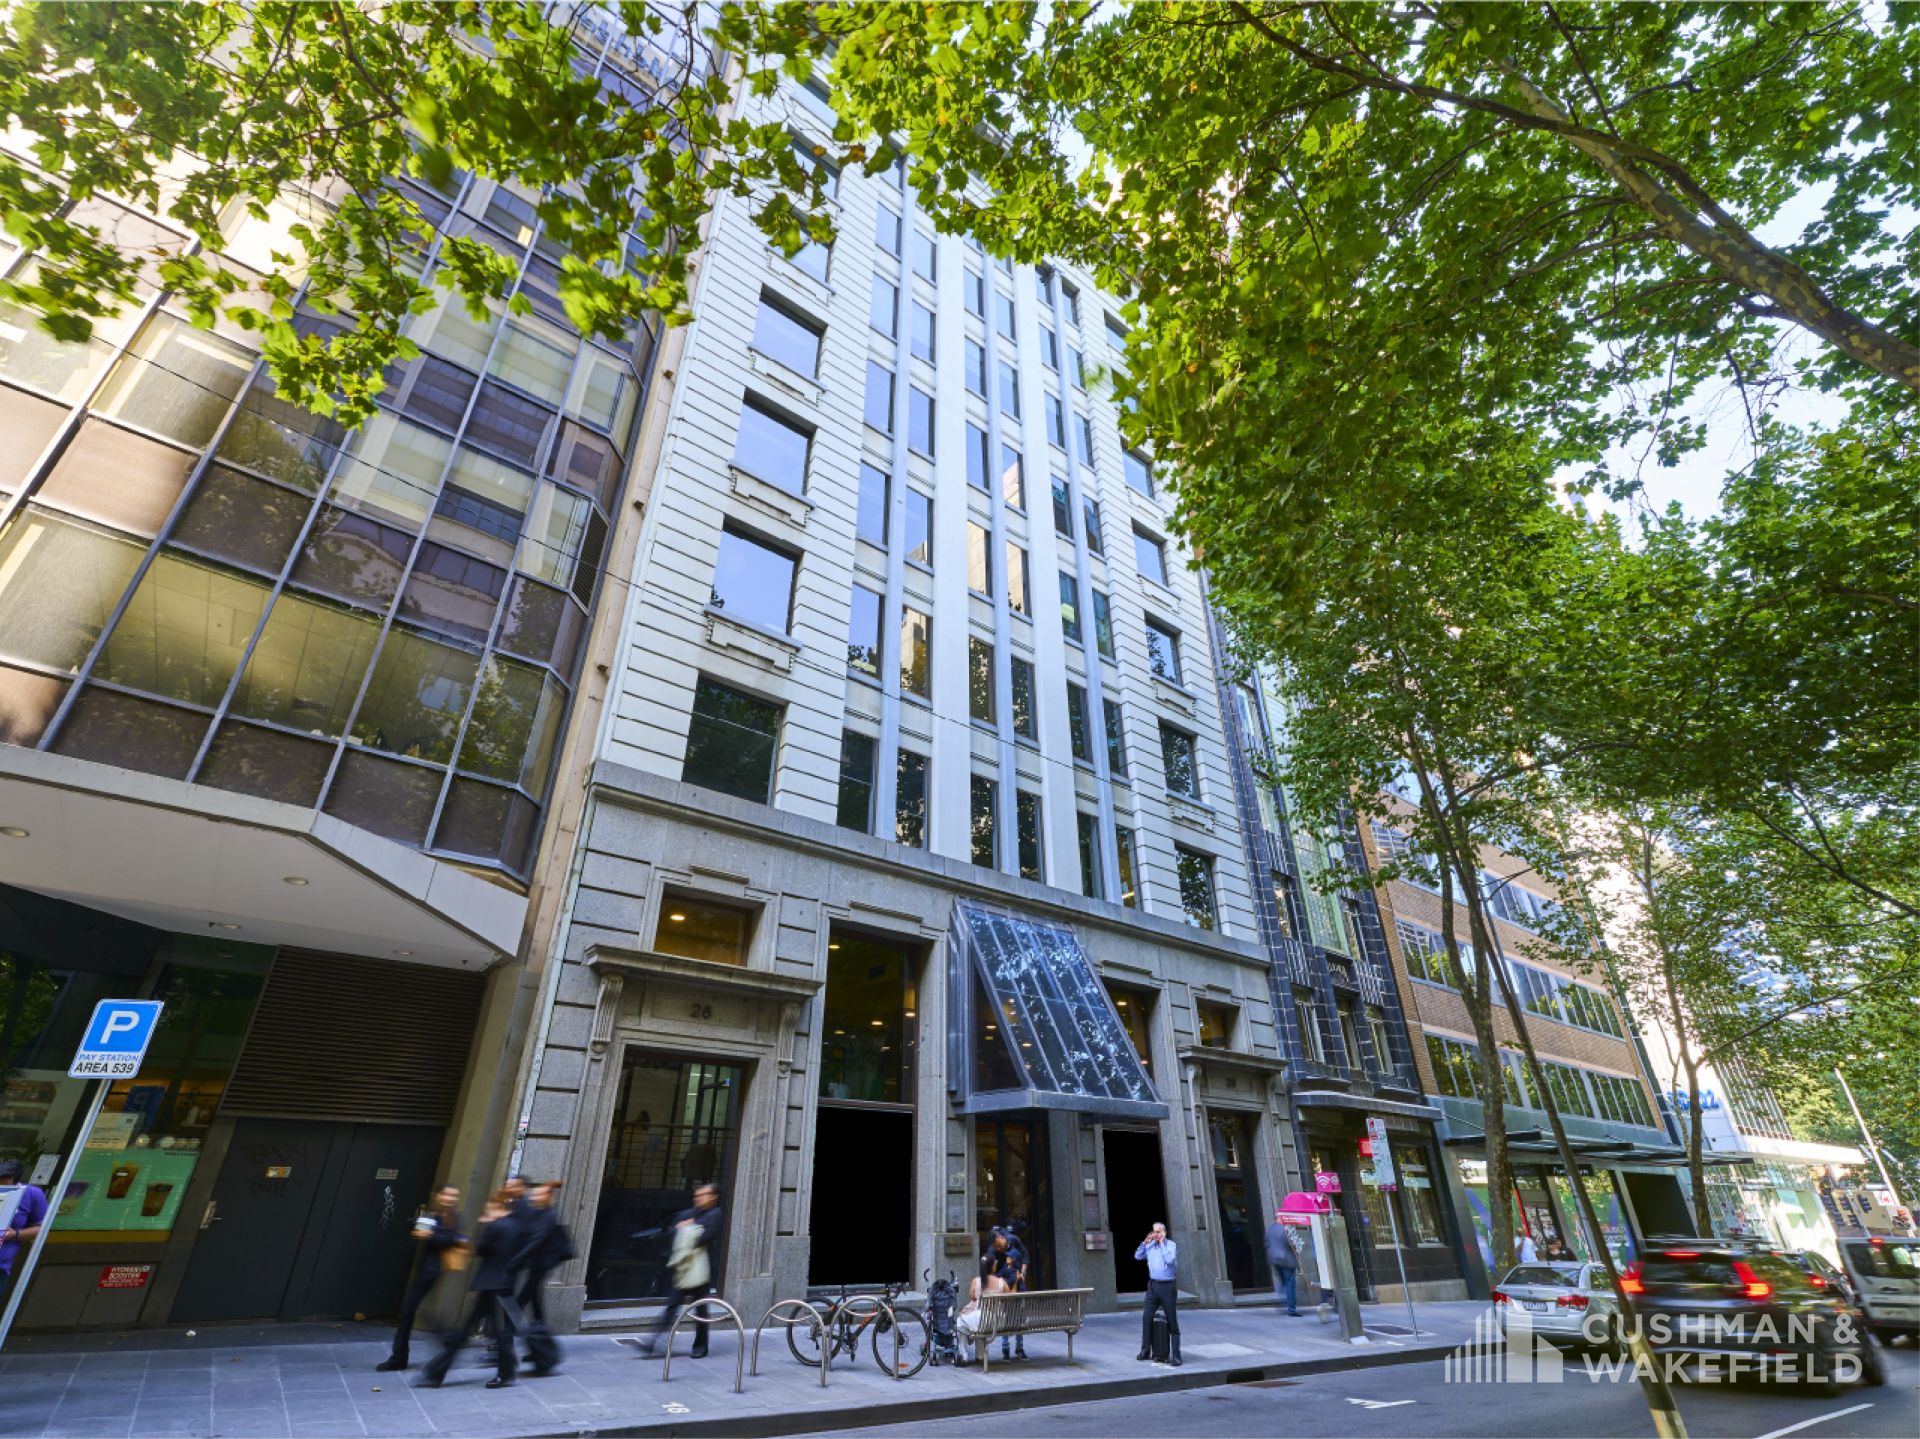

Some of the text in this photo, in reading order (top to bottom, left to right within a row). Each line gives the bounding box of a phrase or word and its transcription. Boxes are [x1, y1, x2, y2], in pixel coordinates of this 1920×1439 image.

[100, 1010, 139, 1044] P
[99, 1054, 138, 1062] STATION
[75, 1062, 135, 1073] AREA 539
